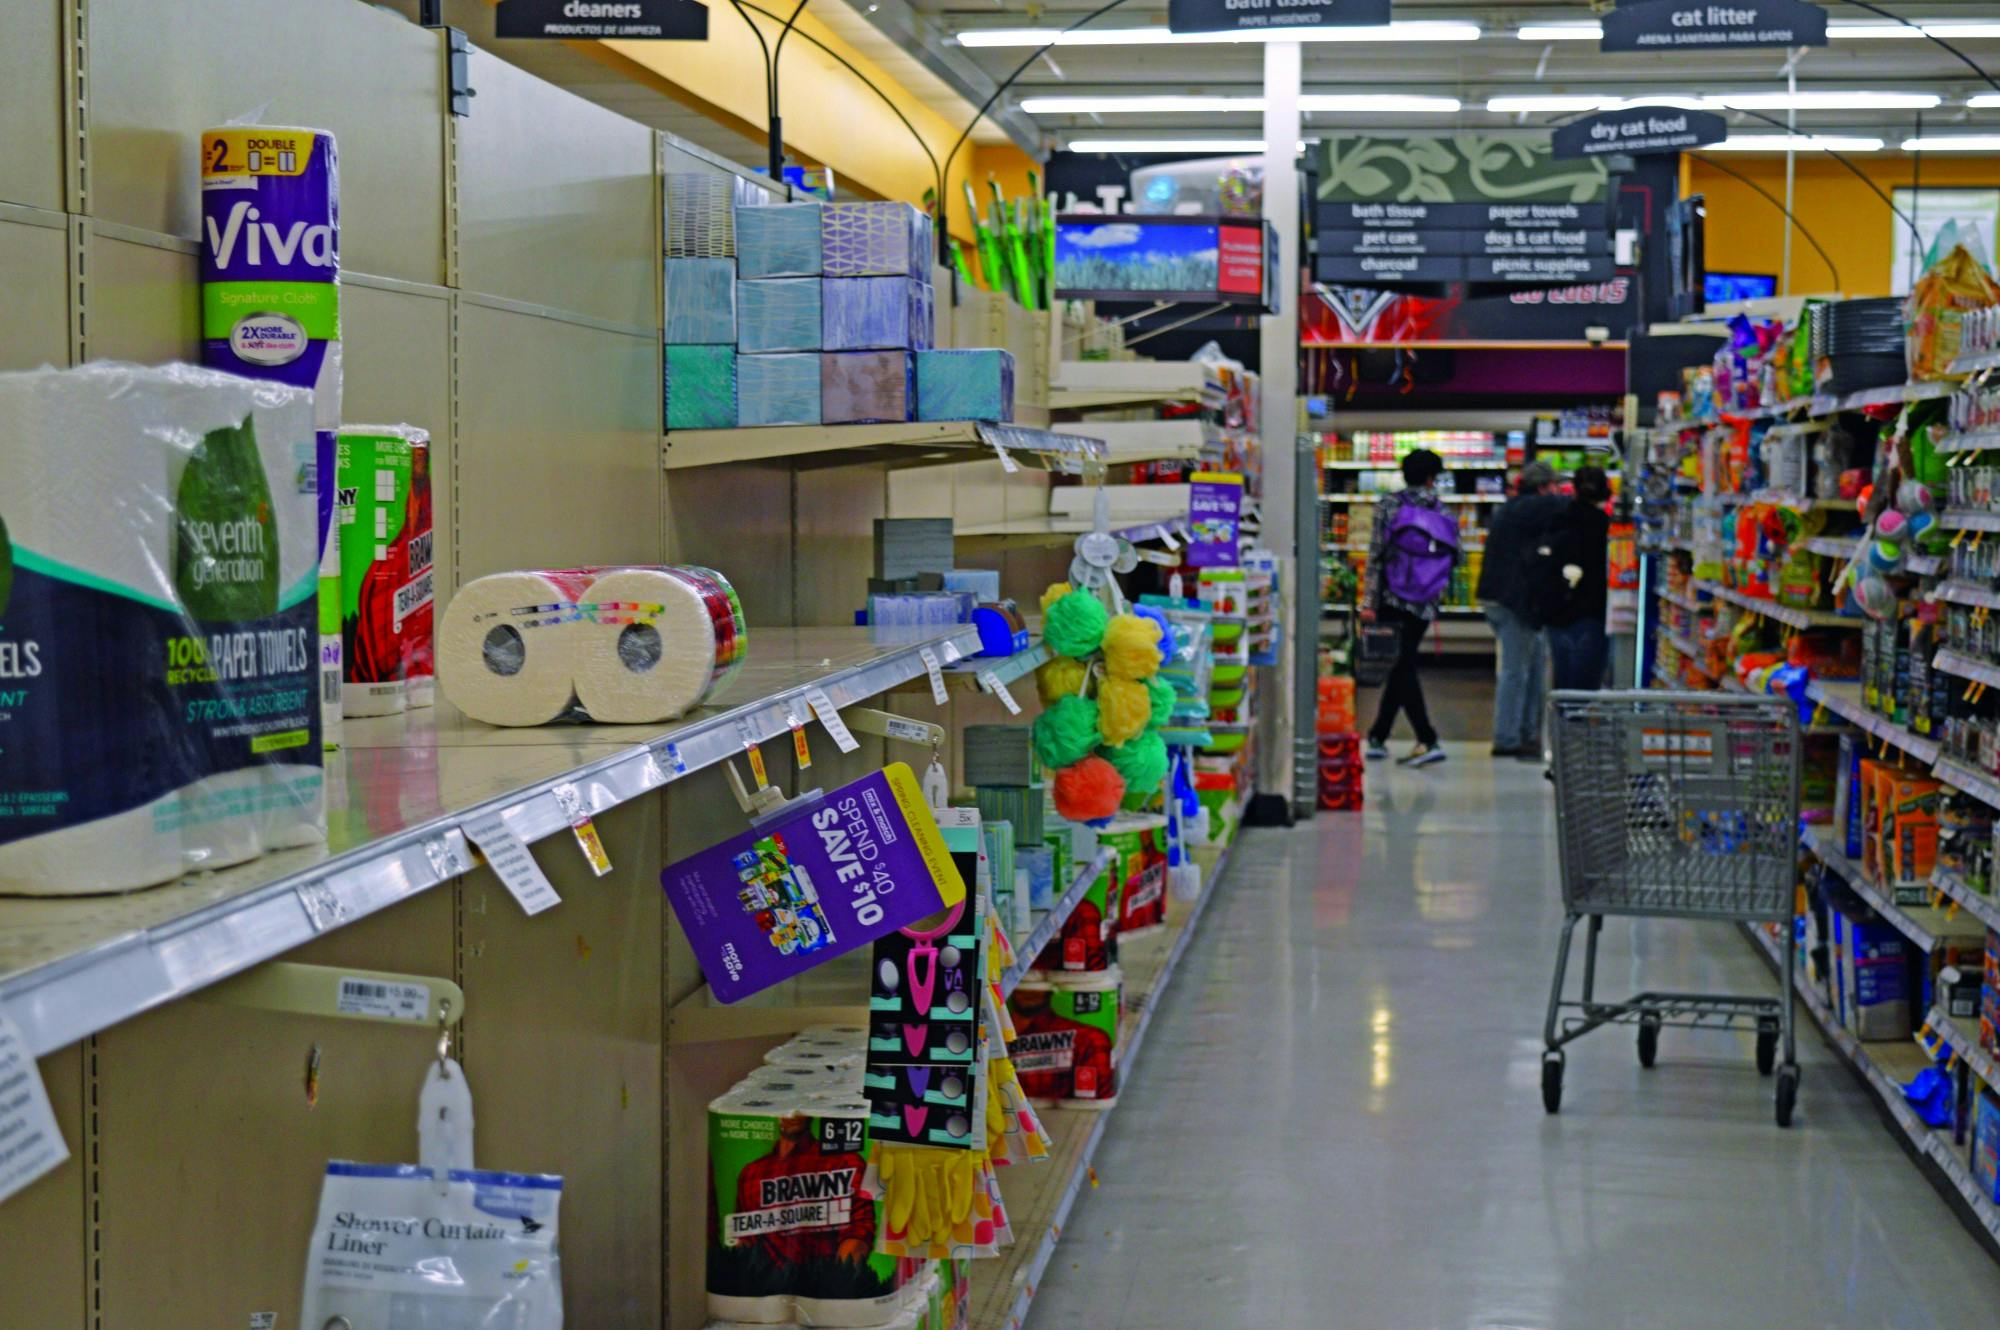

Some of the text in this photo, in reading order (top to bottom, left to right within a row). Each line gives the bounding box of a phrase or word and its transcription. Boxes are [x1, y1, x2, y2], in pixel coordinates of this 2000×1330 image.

[563, 0, 642, 18] cleaners
[1671, 6, 1758, 27] cat litter
[544, 24, 662, 35] PRODUCTOS DE LIMPIEZA
[1238, 15, 1269, 26] PAPEL
[1636, 33, 1672, 45] ARENA
[1728, 30, 1757, 42] PARA
[1758, 29, 1794, 41] GATOS
[1590, 114, 1688, 141] dry cat food
[247, 138, 296, 150] DOUBLE
[212, 139, 229, 173] 2
[1351, 203, 1428, 218] bath tissue
[1488, 203, 1579, 221] paper towels
[206, 201, 333, 270] Viva
[1362, 231, 1418, 247] pet care
[1484, 229, 1587, 247] dog & cat food
[1360, 256, 1419, 271] charcoal
[1491, 256, 1592, 274] picnic supplies
[220, 291, 318, 307] Signature Cloth
[241, 326, 260, 340] 2X
[190, 515, 264, 555] seventh
[192, 555, 264, 591] generation
[212, 627, 308, 680] PAPER TOWELS
[876, 814, 893, 841] match
[837, 797, 896, 895] SPEND $40
[907, 811, 934, 857] CLEANING
[930, 856, 948, 886] EVENT
[812, 807, 884, 926] SAVE $10
[724, 942, 743, 971] more
[722, 955, 740, 982] save
[720, 1119, 741, 1128] MORE
[825, 1122, 835, 1140] 6
[844, 1121, 863, 1142] 12
[729, 1130, 749, 1139] MORE
[761, 1169, 856, 1207] BRAWNY
[331, 1211, 506, 1241] Shower Curtain
[732, 1205, 825, 1232] TEAR-A-SQUARE
[327, 1231, 389, 1256] Liner
